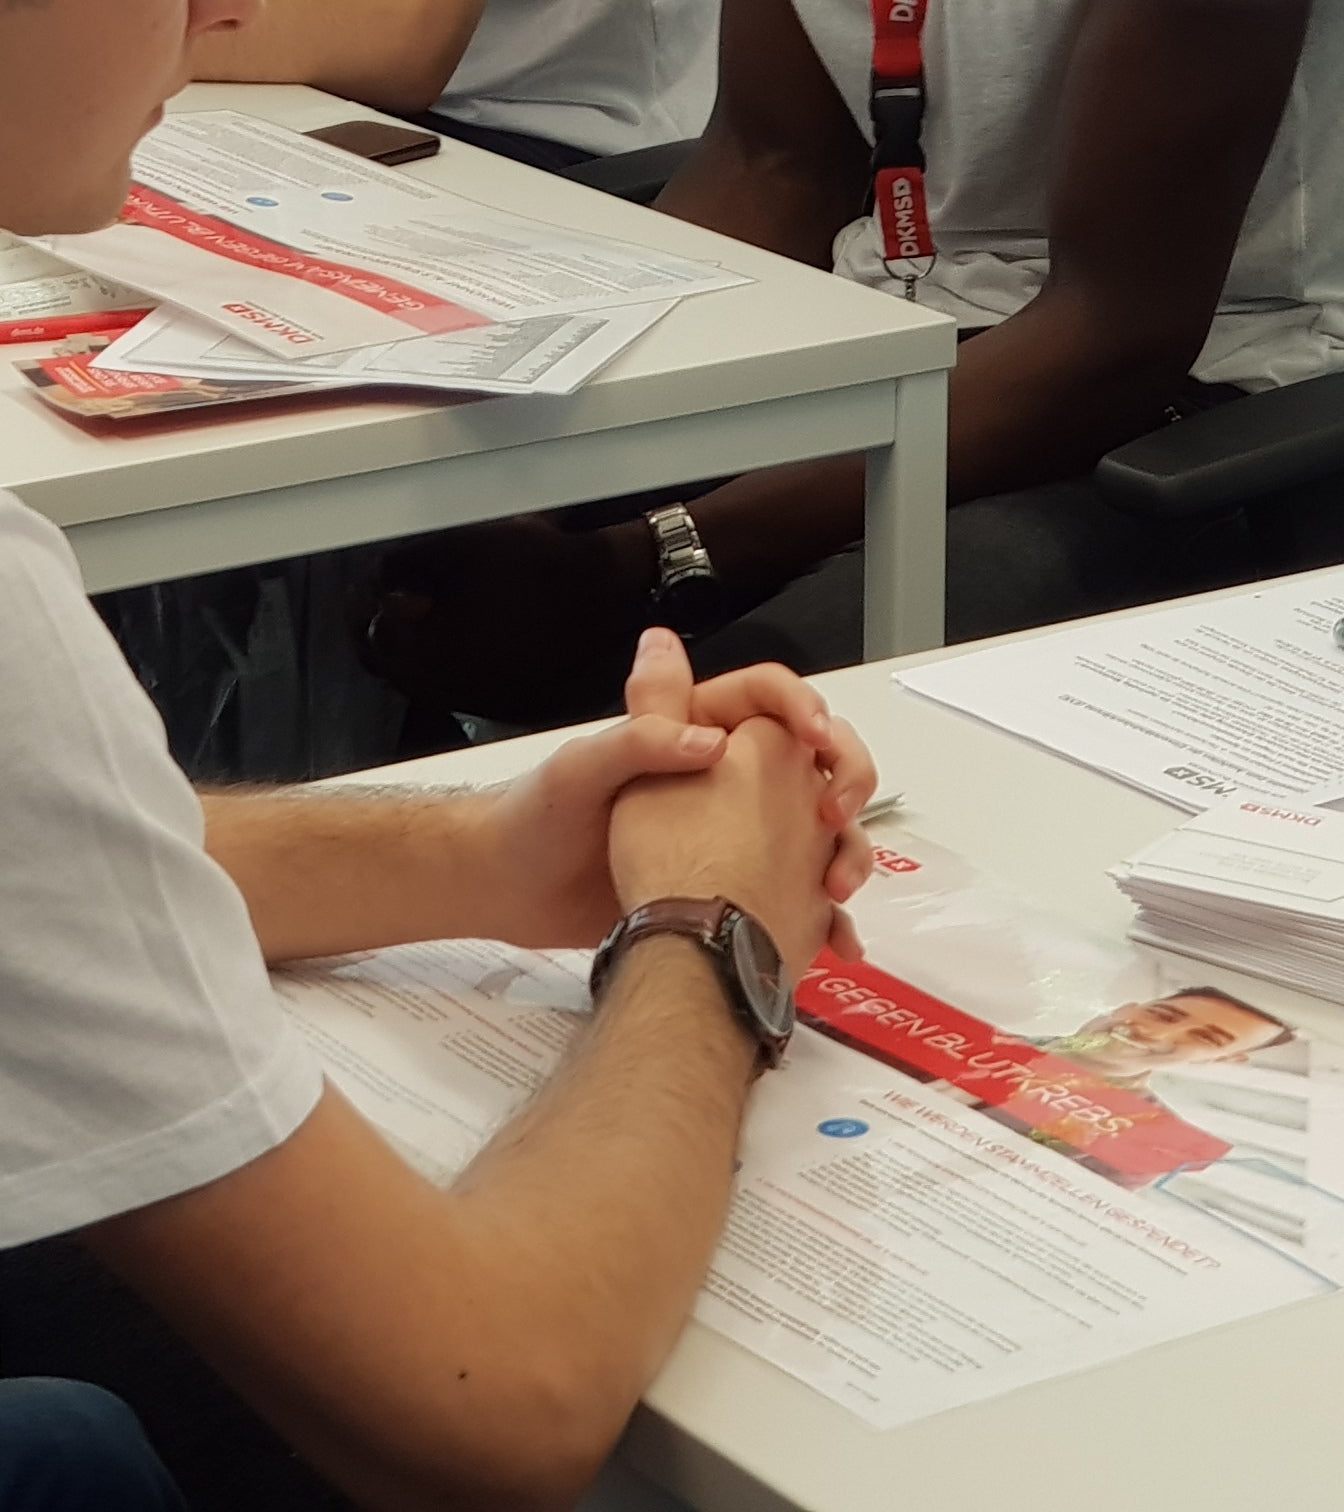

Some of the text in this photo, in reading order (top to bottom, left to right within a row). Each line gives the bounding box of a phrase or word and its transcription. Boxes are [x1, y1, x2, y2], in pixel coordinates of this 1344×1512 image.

[893, 195, 921, 257] DKMS
[241, 308, 317, 345] DKMS
[1193, 774, 1238, 798] MS
[1257, 805, 1322, 827] DKMS
[819, 977, 1135, 1138] GEGEN BLUTKREBS.
